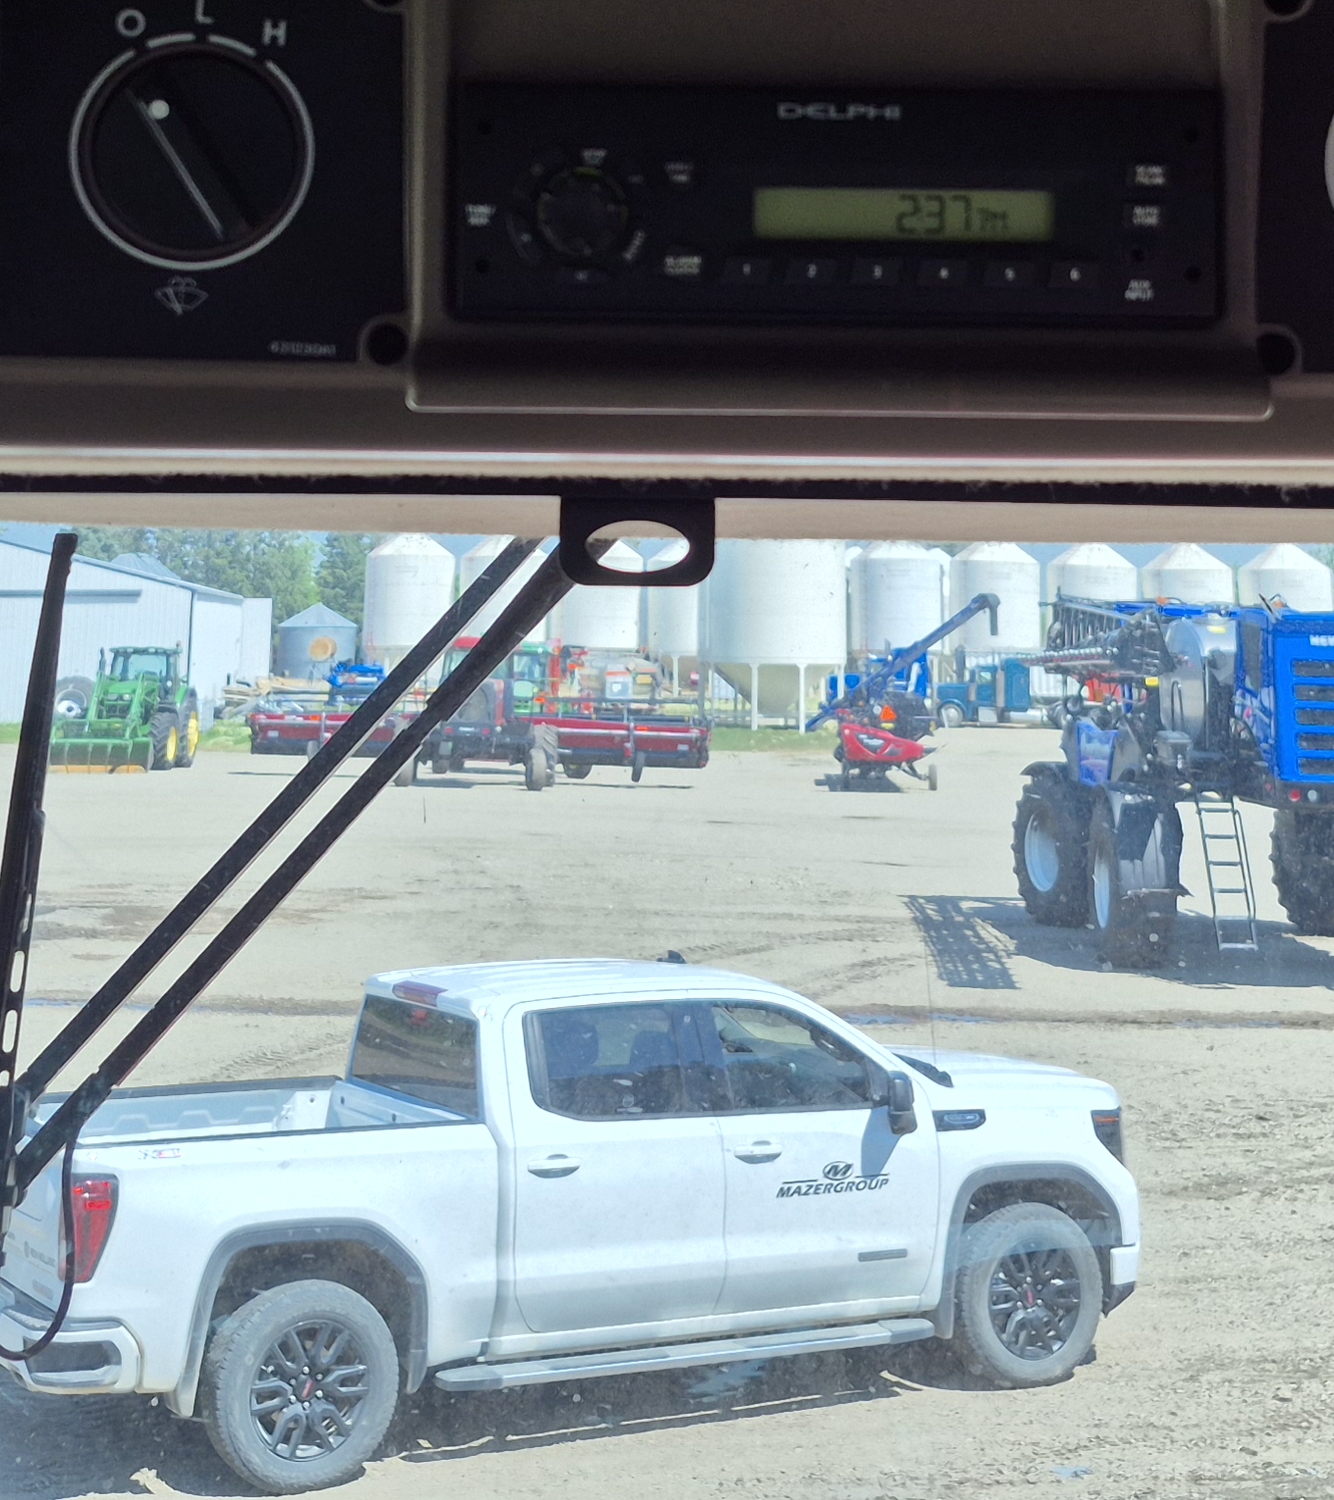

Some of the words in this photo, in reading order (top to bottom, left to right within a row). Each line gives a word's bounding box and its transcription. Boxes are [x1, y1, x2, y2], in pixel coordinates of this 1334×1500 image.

[262, 18, 287, 47] H
[775, 101, 903, 122] DELPHI
[775, 1178, 890, 1198] MAZERGROUP
